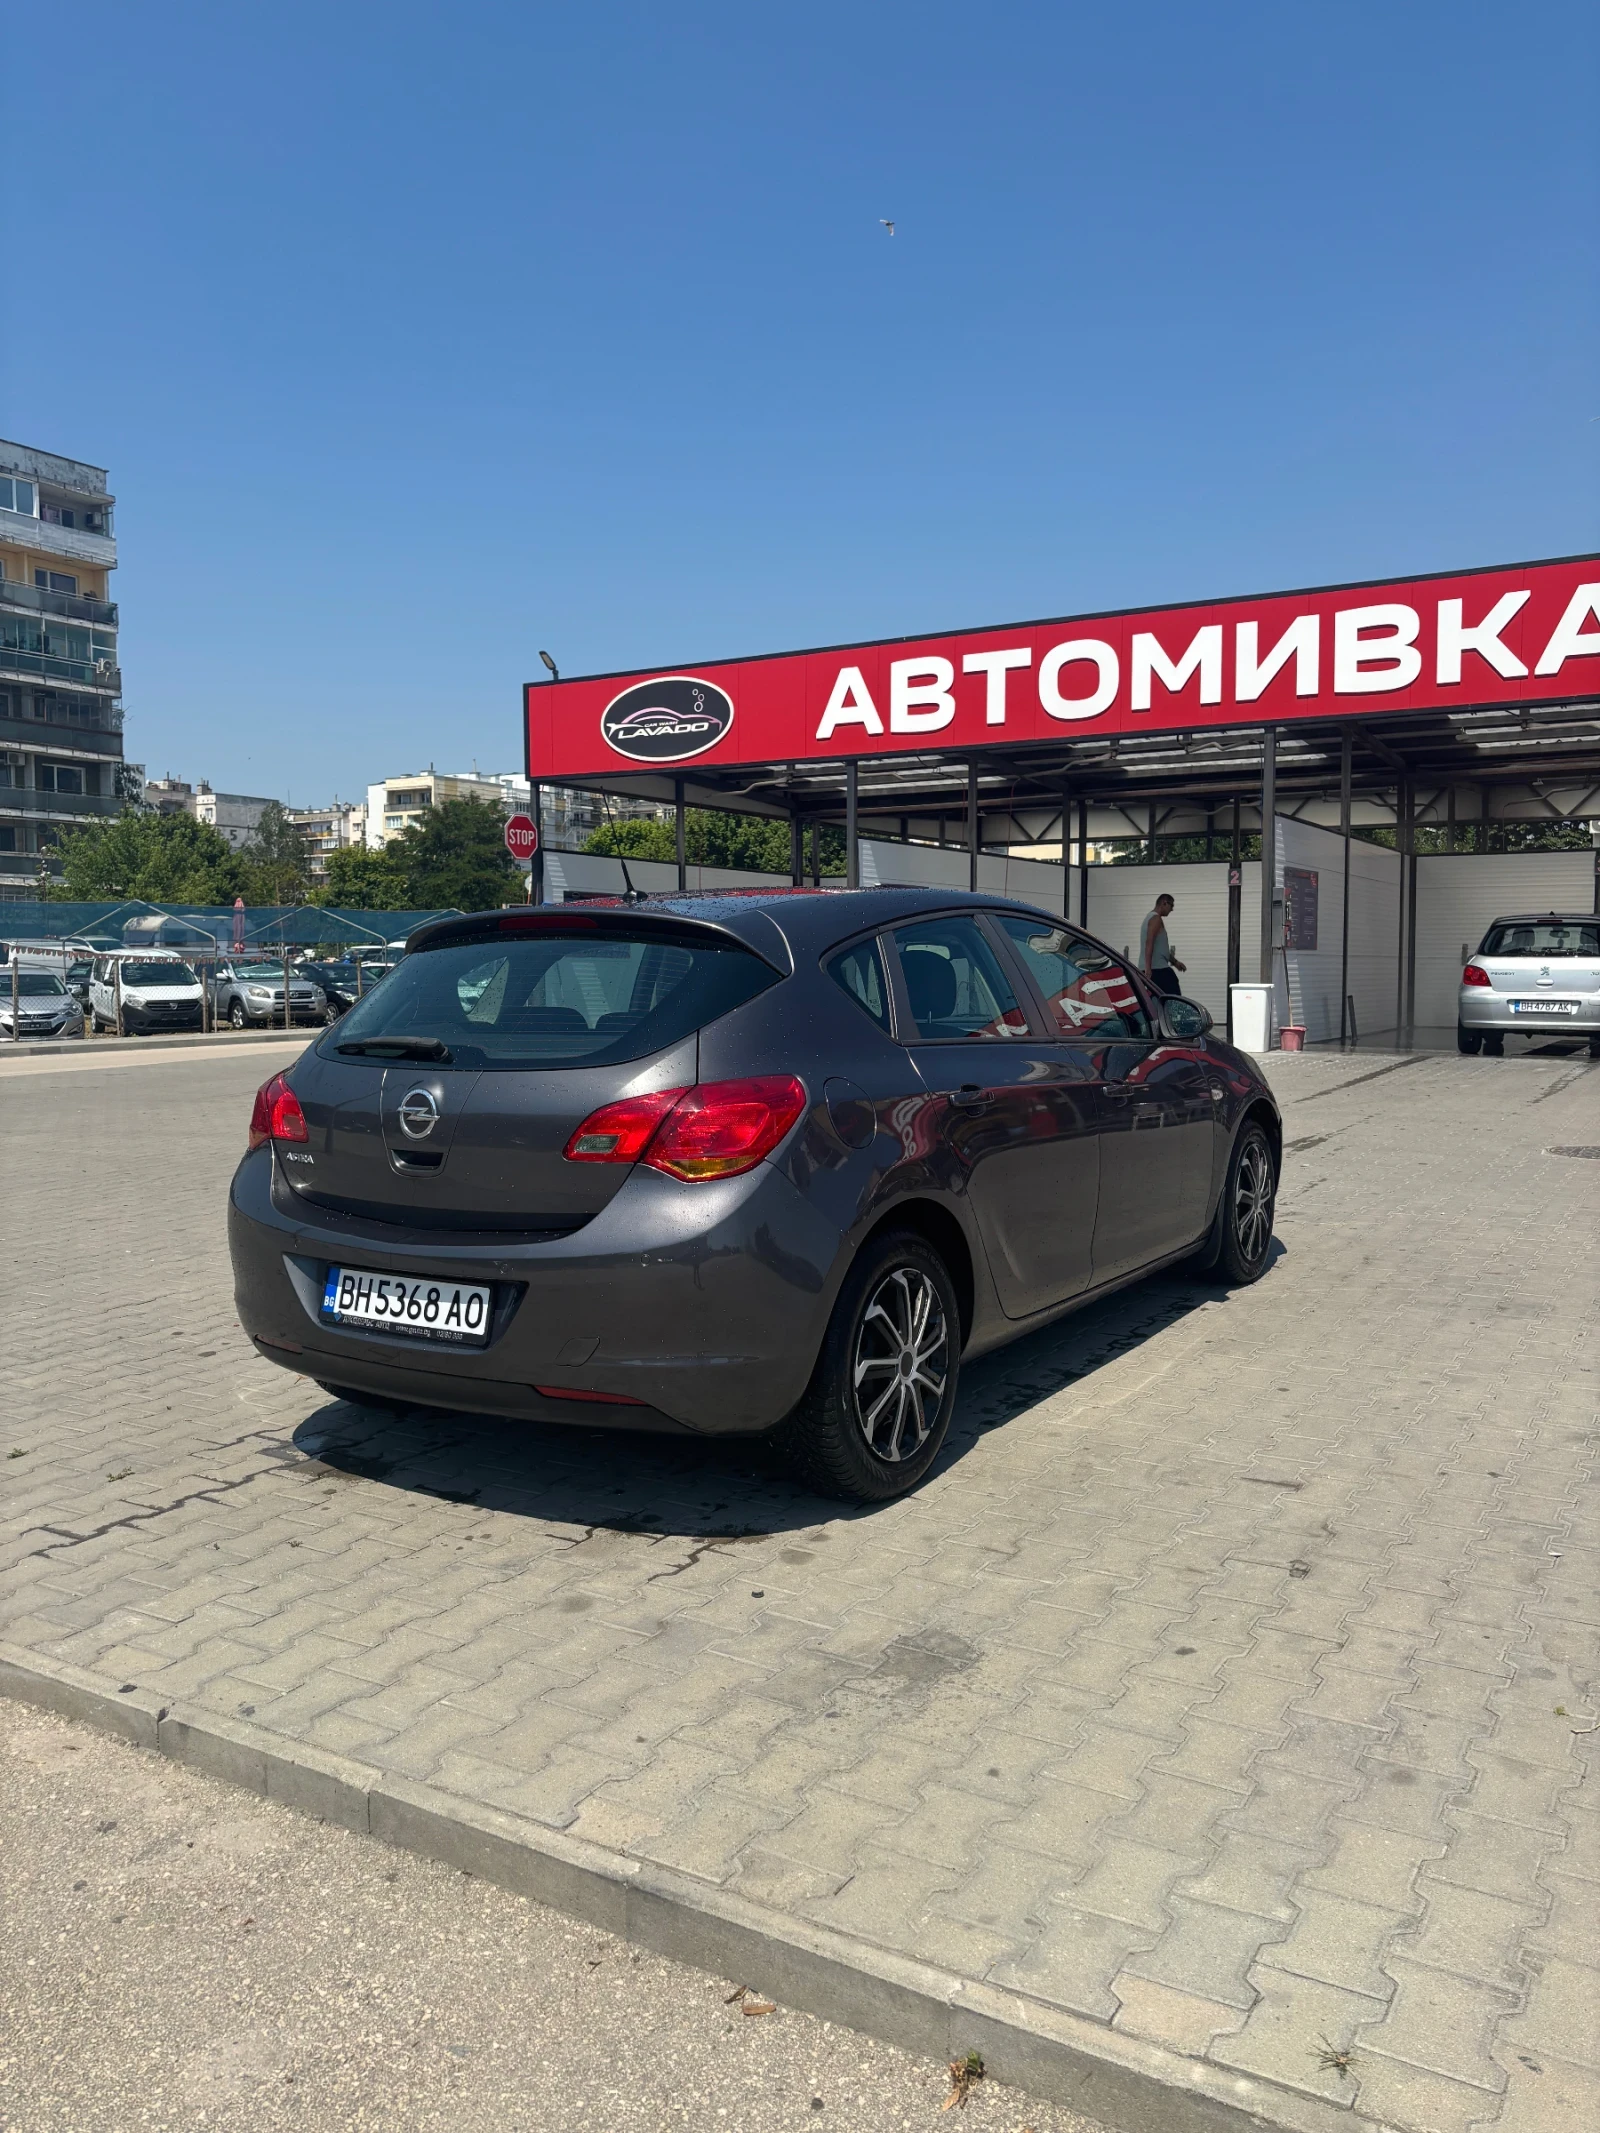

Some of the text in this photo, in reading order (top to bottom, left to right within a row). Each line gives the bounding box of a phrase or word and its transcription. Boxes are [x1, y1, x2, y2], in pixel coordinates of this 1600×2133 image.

[815, 582, 1600, 740] АВТОМИВКА
[618, 722, 709, 740] LAVADO
[509, 828, 535, 846] STOP
[1230, 870, 1240, 884] 2
[286, 1152, 314, 1164] ASTRA
[323, 1295, 335, 1307] BG
